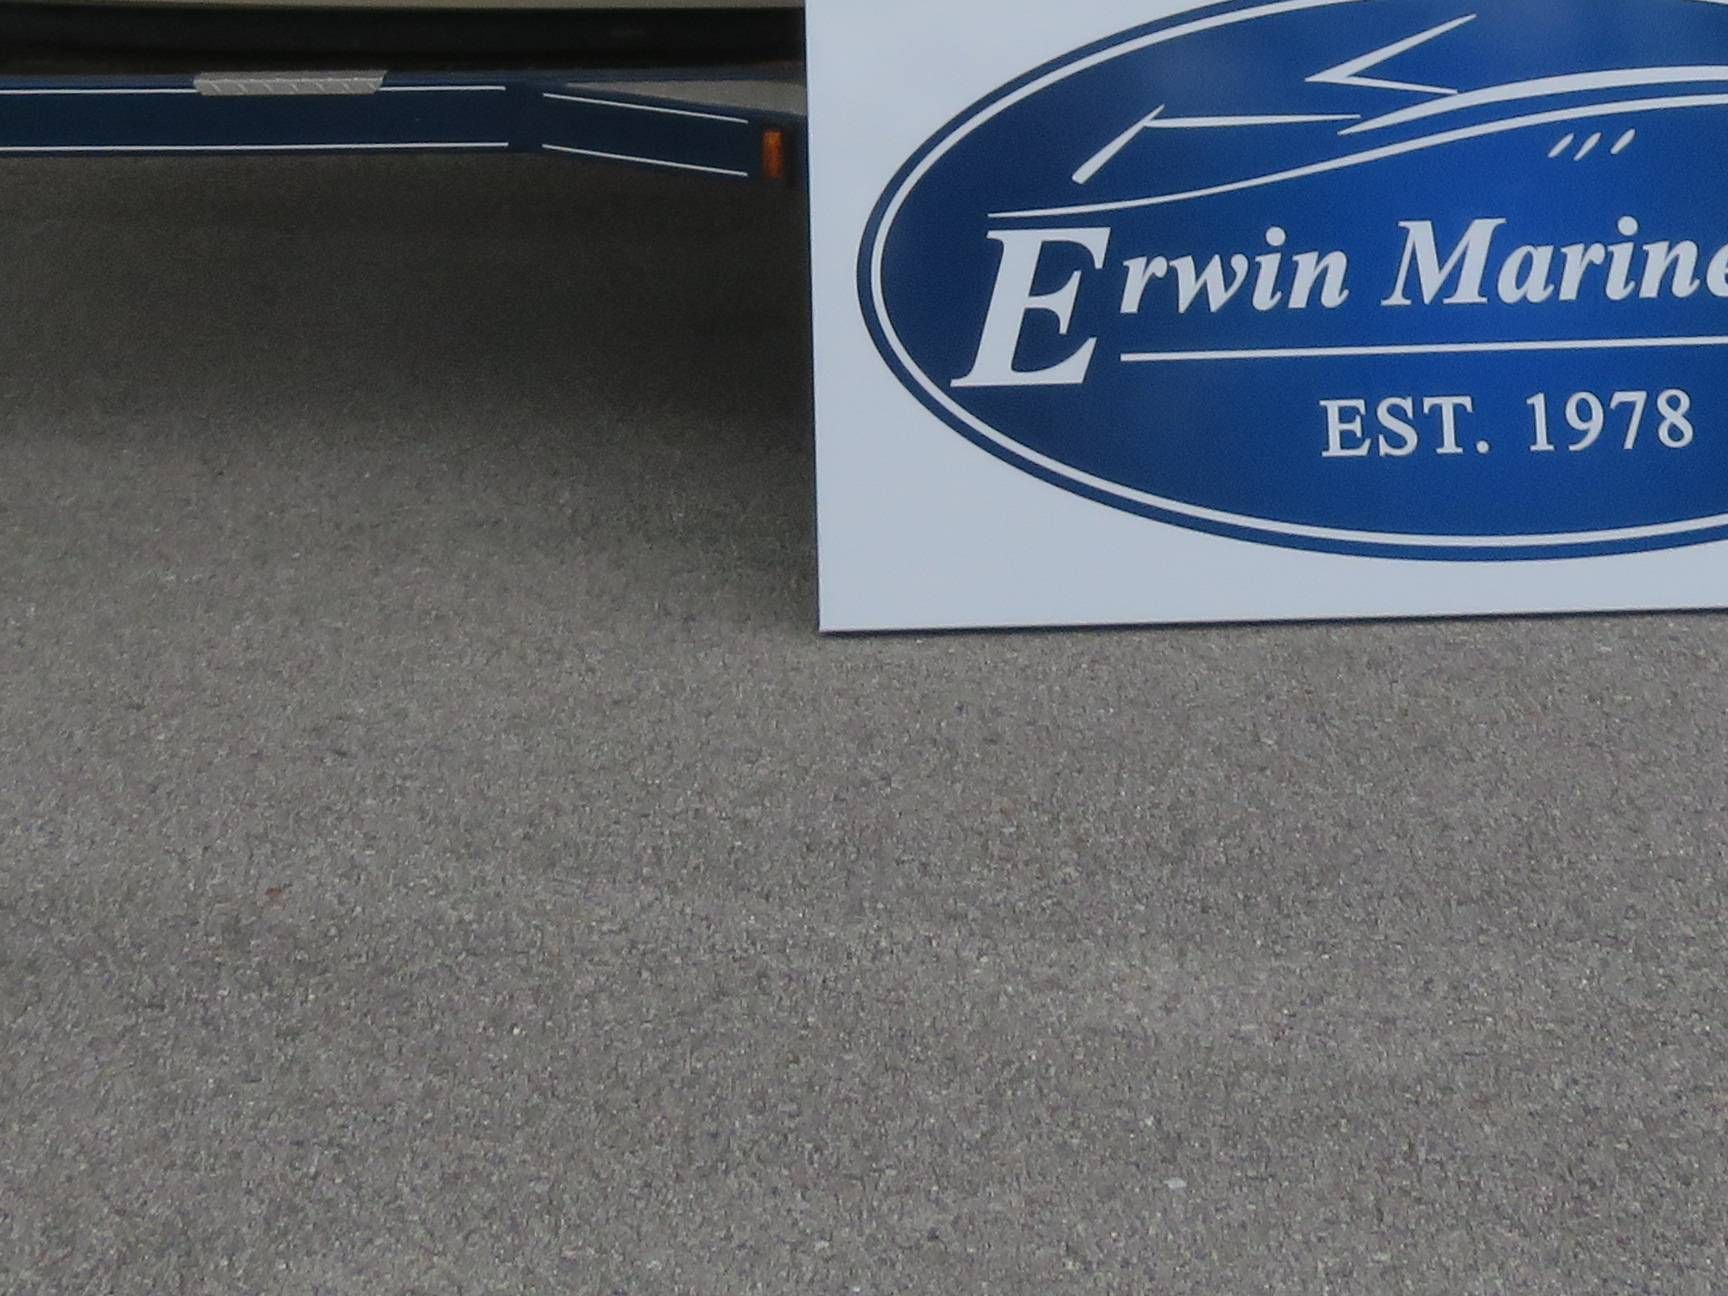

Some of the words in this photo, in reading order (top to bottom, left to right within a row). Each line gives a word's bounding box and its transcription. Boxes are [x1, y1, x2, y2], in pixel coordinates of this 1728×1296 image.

[949, 226, 1350, 388] Erwin
[1319, 394, 1489, 457] EST.
[1526, 388, 1694, 452] 1978
